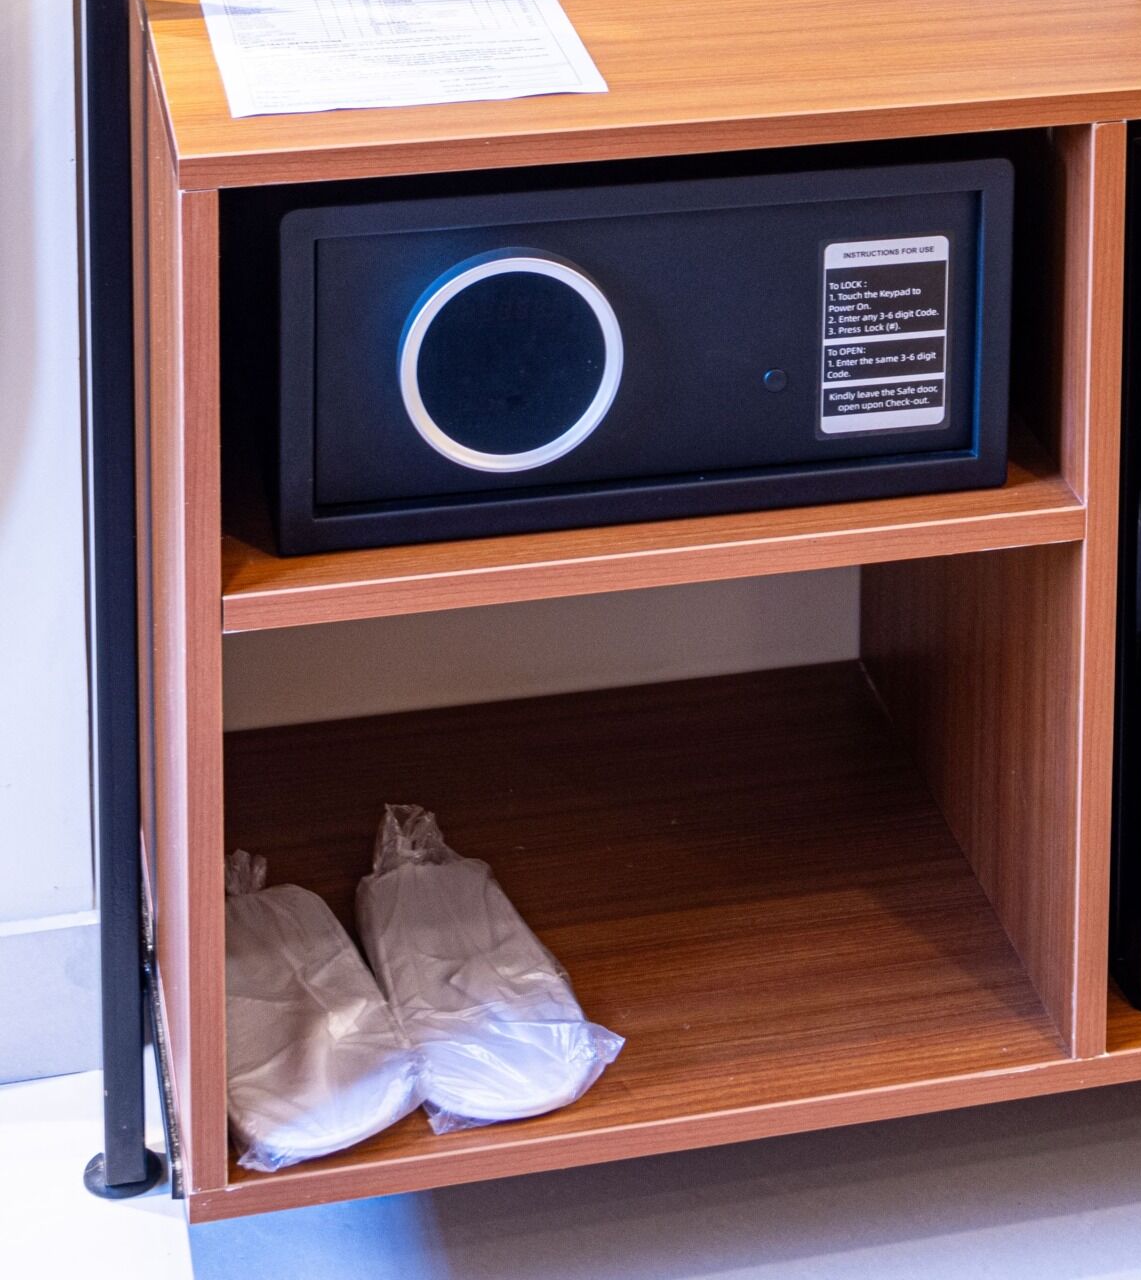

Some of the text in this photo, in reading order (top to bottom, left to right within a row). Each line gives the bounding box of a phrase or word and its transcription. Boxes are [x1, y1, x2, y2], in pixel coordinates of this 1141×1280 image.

[843, 248, 899, 259] INSTRUCTIONS
[901, 247, 917, 255] FOR
[829, 282, 839, 290] To
[841, 281, 862, 290] LOCK
[838, 291, 863, 301] Touch
[864, 291, 878, 299] the
[879, 288, 911, 299] Keypad
[828, 303, 871, 313] Power On.
[828, 308, 939, 324] 2. Enter any 3-6 digit Code.
[828, 327, 836, 335] 3.
[838, 325, 861, 334] Press
[864, 323, 884, 332] Lock
[827, 346, 866, 356] To OPEN:
[836, 357, 858, 367] Enter
[860, 356, 873, 365] the
[875, 355, 898, 364] same
[900, 354, 915, 362] 3-6
[917, 352, 936, 362] digit
[827, 370, 851, 378] Code.
[829, 392, 855, 401] Kindly
[857, 390, 880, 399] leave
[881, 388, 895, 397] the
[897, 386, 915, 396] Safe
[838, 403, 859, 413] open
[861, 401, 883, 410] upon
